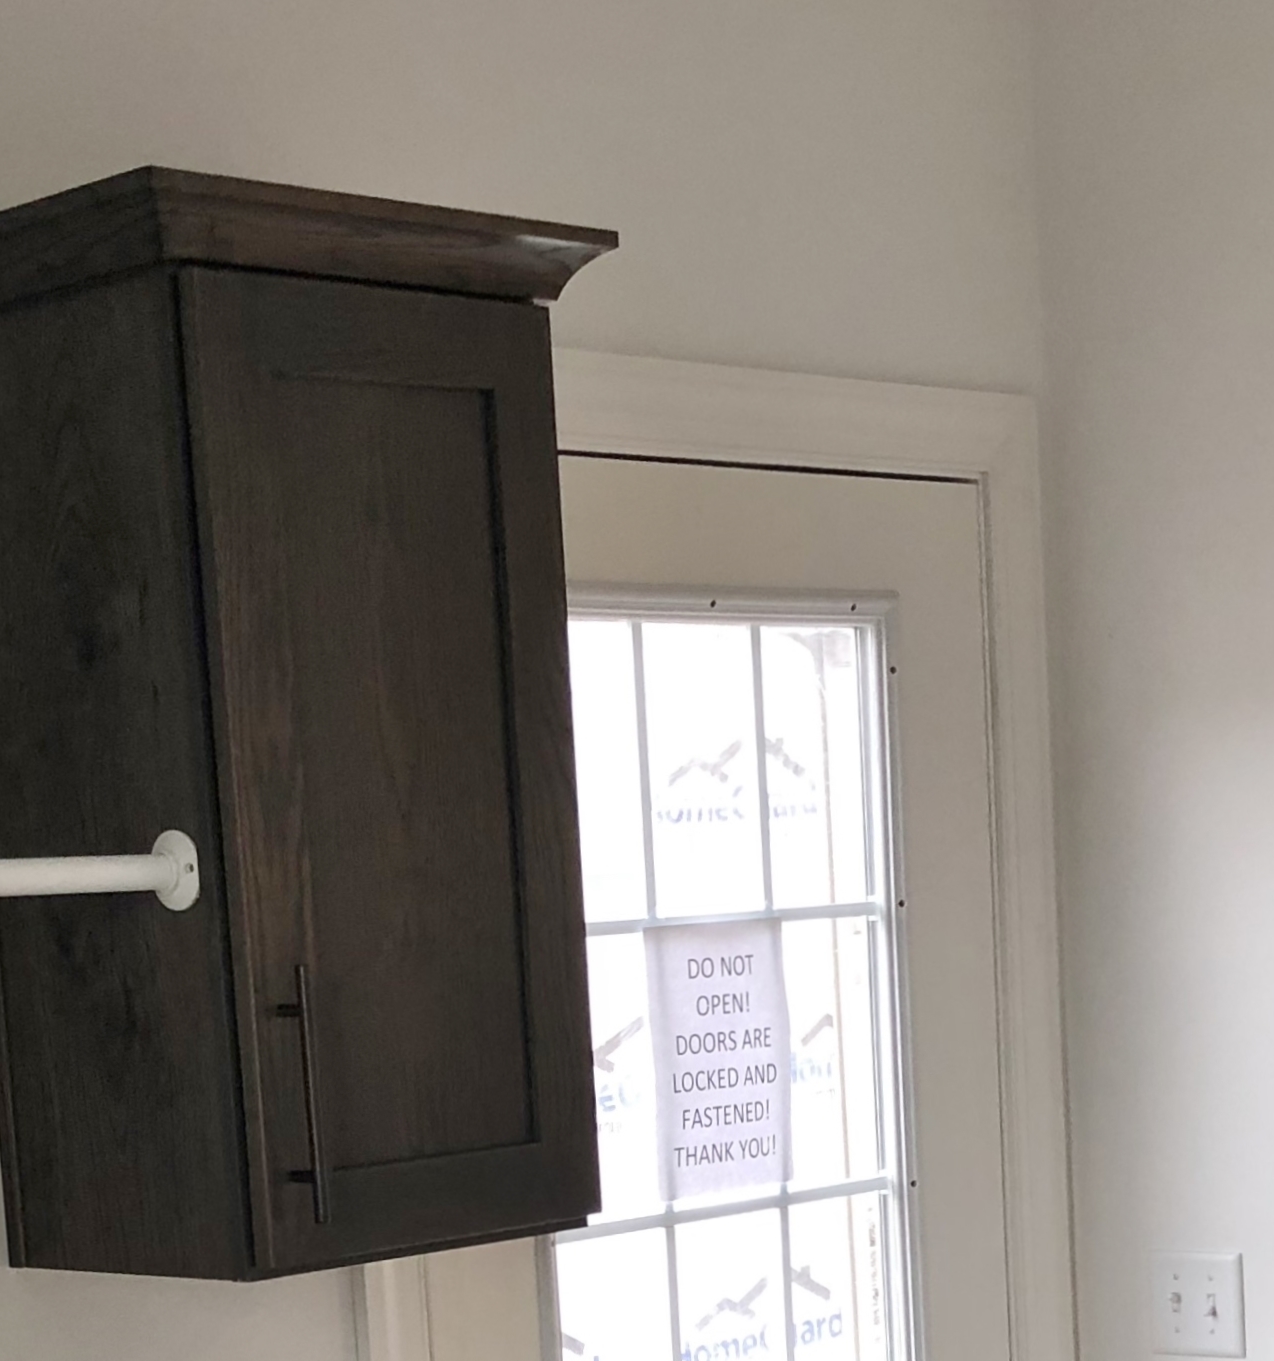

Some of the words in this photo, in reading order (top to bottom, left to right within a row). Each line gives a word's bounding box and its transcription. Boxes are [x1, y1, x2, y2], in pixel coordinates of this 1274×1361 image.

[687, 957, 715, 979] DO
[720, 954, 754, 977] NOT
[696, 991, 751, 1016] OPEN!
[676, 1030, 737, 1056] DOORS
[742, 1027, 772, 1049] ARE
[672, 1067, 739, 1093] LOCKED
[743, 1063, 777, 1086] AND
[682, 1099, 770, 1130] FASTENED!
[674, 1141, 735, 1168] THANK
[738, 1134, 776, 1161] YOU!
